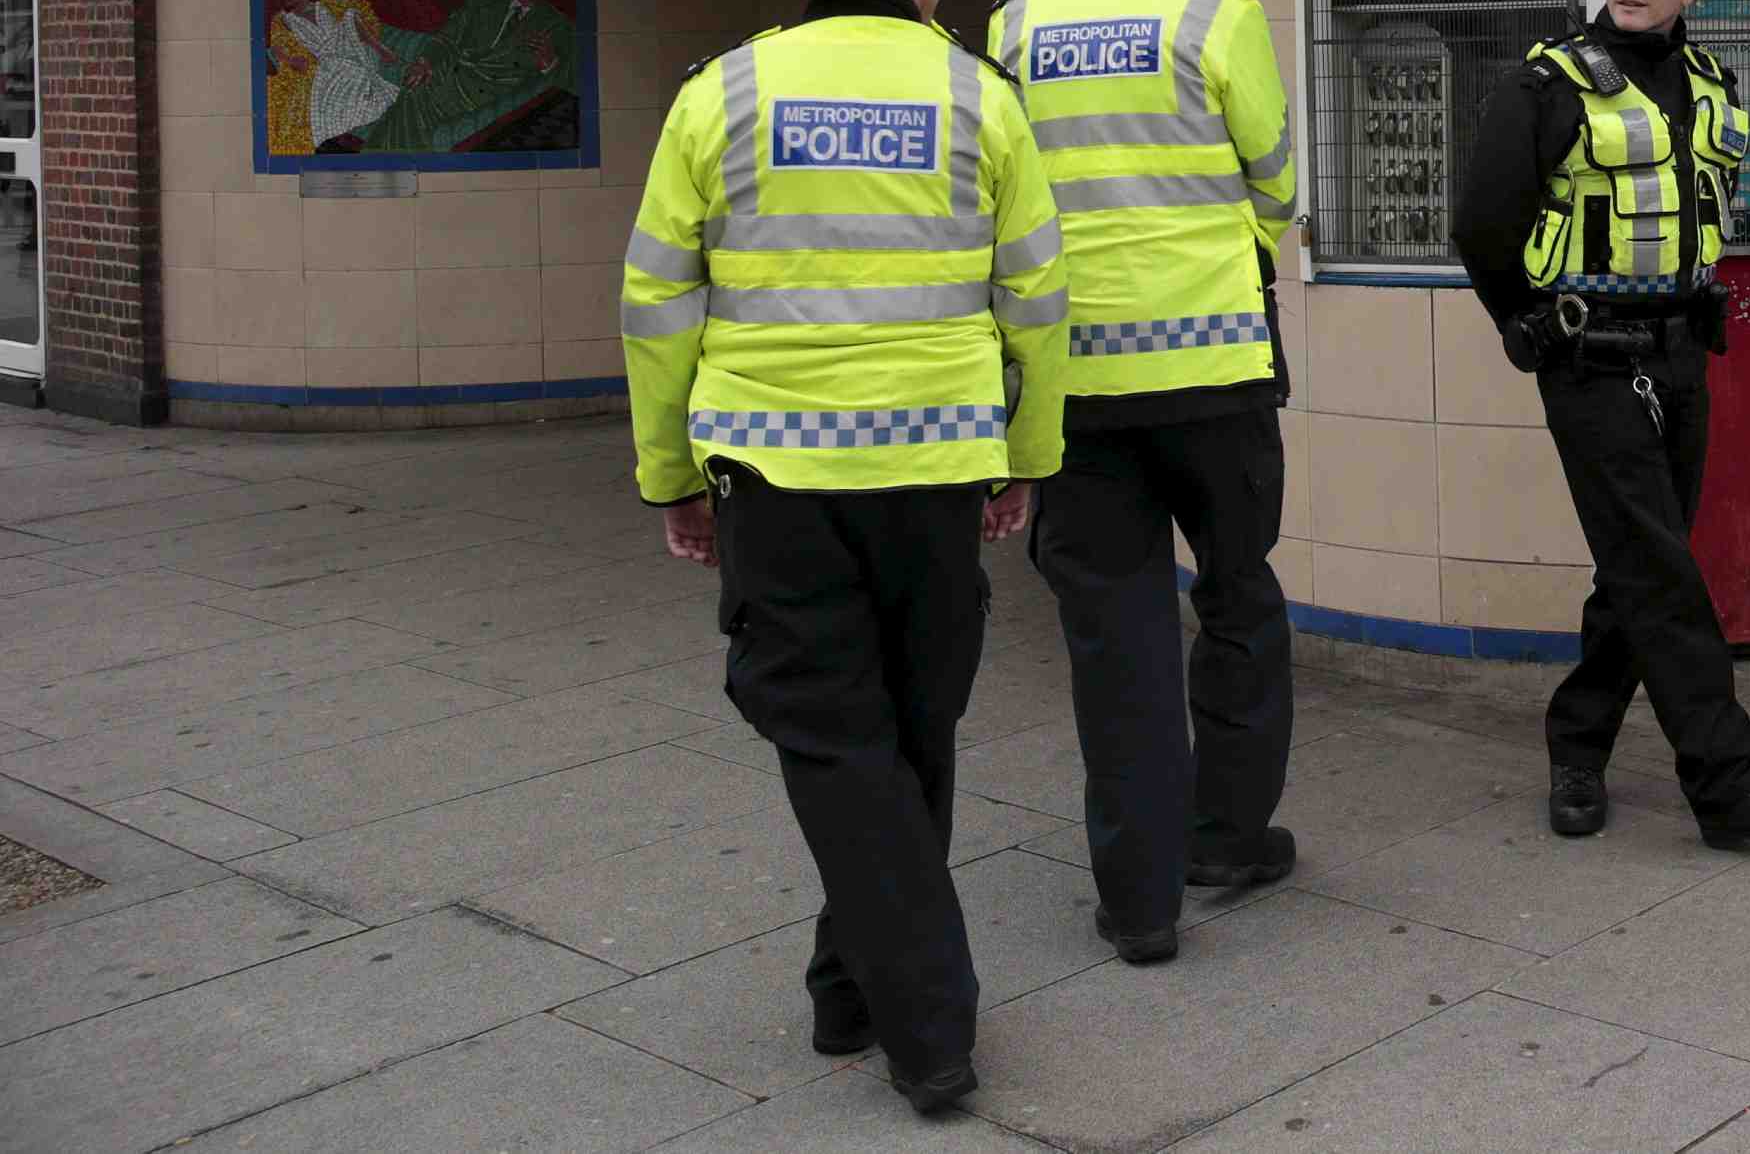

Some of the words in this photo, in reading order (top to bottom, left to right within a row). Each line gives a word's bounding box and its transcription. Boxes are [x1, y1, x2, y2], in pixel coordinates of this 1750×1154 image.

[1038, 22, 1152, 44] METROPOLITAN
[1037, 40, 1150, 76] POLICE
[783, 106, 926, 127] METROPOLITAN
[782, 126, 926, 164] POLICE
